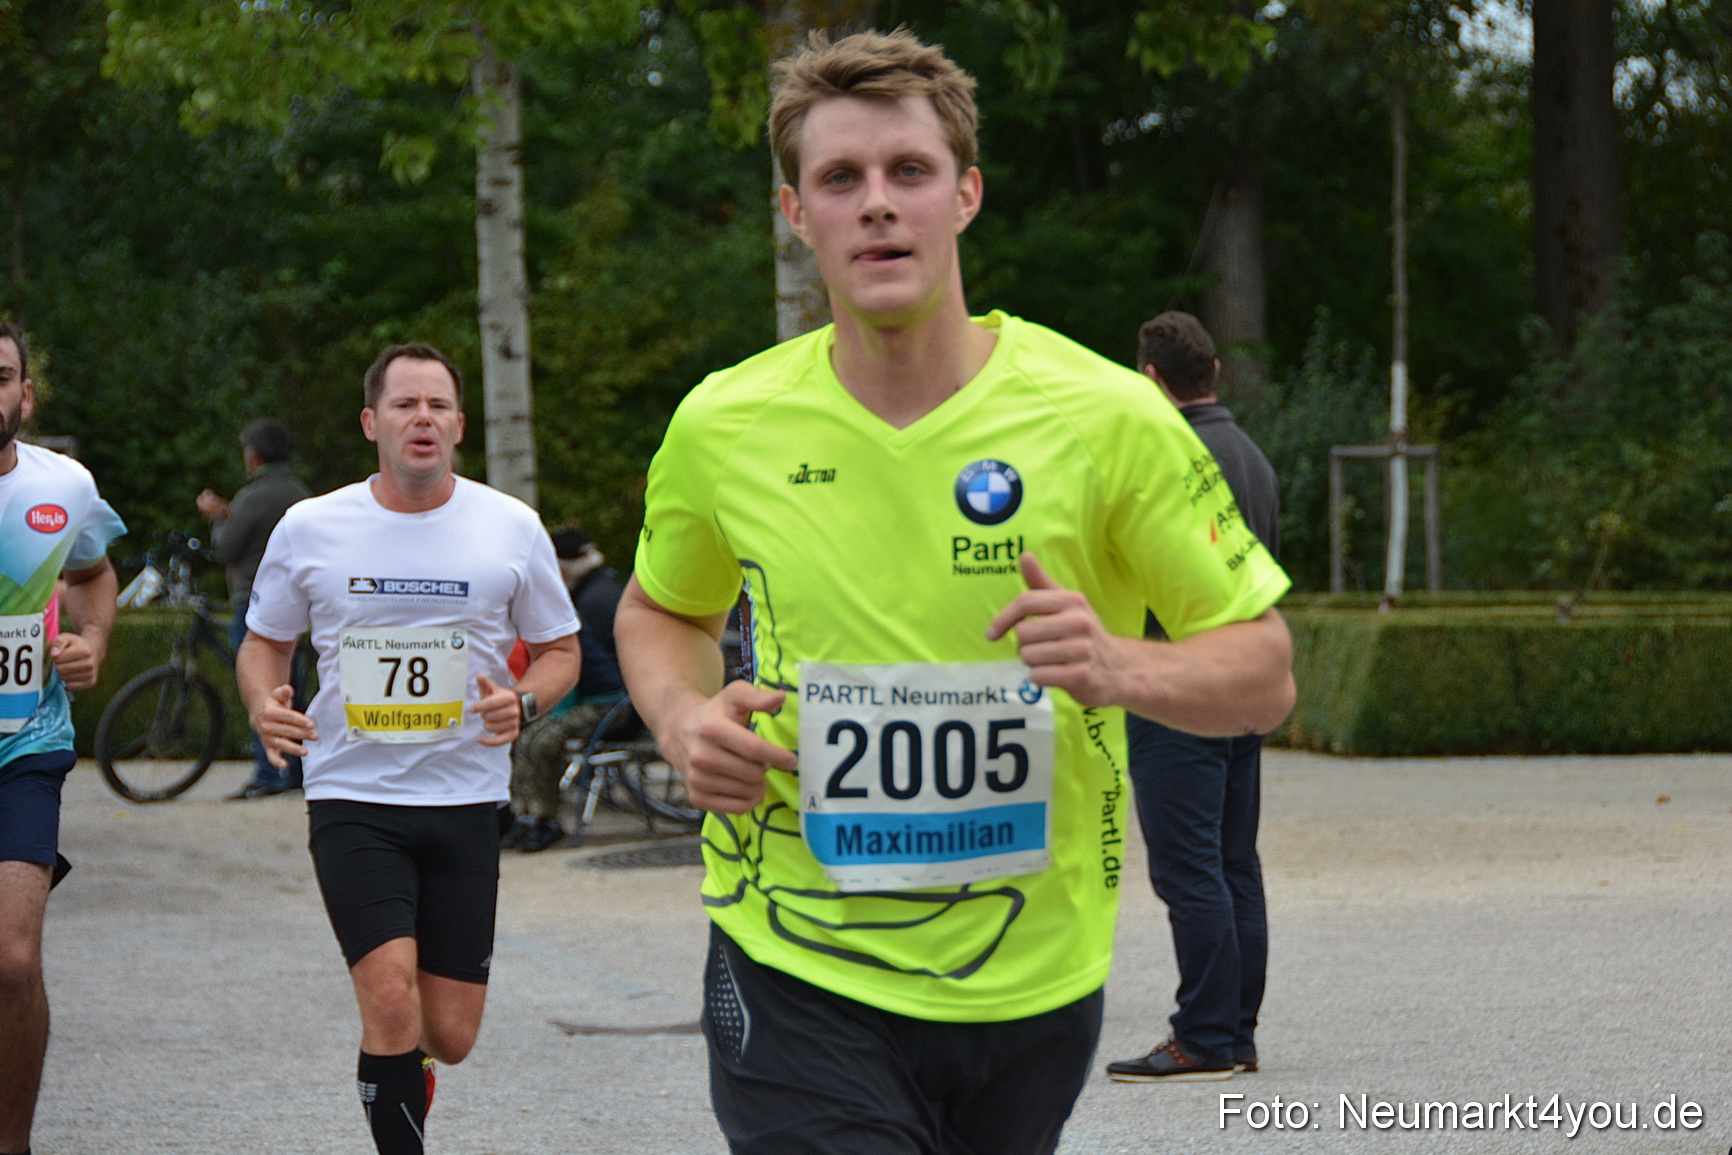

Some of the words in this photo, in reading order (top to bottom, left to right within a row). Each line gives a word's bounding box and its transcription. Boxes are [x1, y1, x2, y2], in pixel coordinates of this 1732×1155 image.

[959, 461, 1018, 482] BMW
[31, 510, 65, 526] Hervis
[953, 535, 1023, 560] Partl
[953, 562, 1019, 576] Neumark
[384, 580, 466, 596] BÜSCHEL
[342, 638, 381, 650] PARTL
[385, 638, 446, 650] Neumarkt
[378, 657, 430, 698] 78
[805, 683, 883, 706] PARTL
[891, 686, 1008, 706] Neumarkt
[363, 710, 442, 729] Wolfgang
[825, 718, 1029, 800] 2005
[836, 820, 1014, 857] Maximilian
